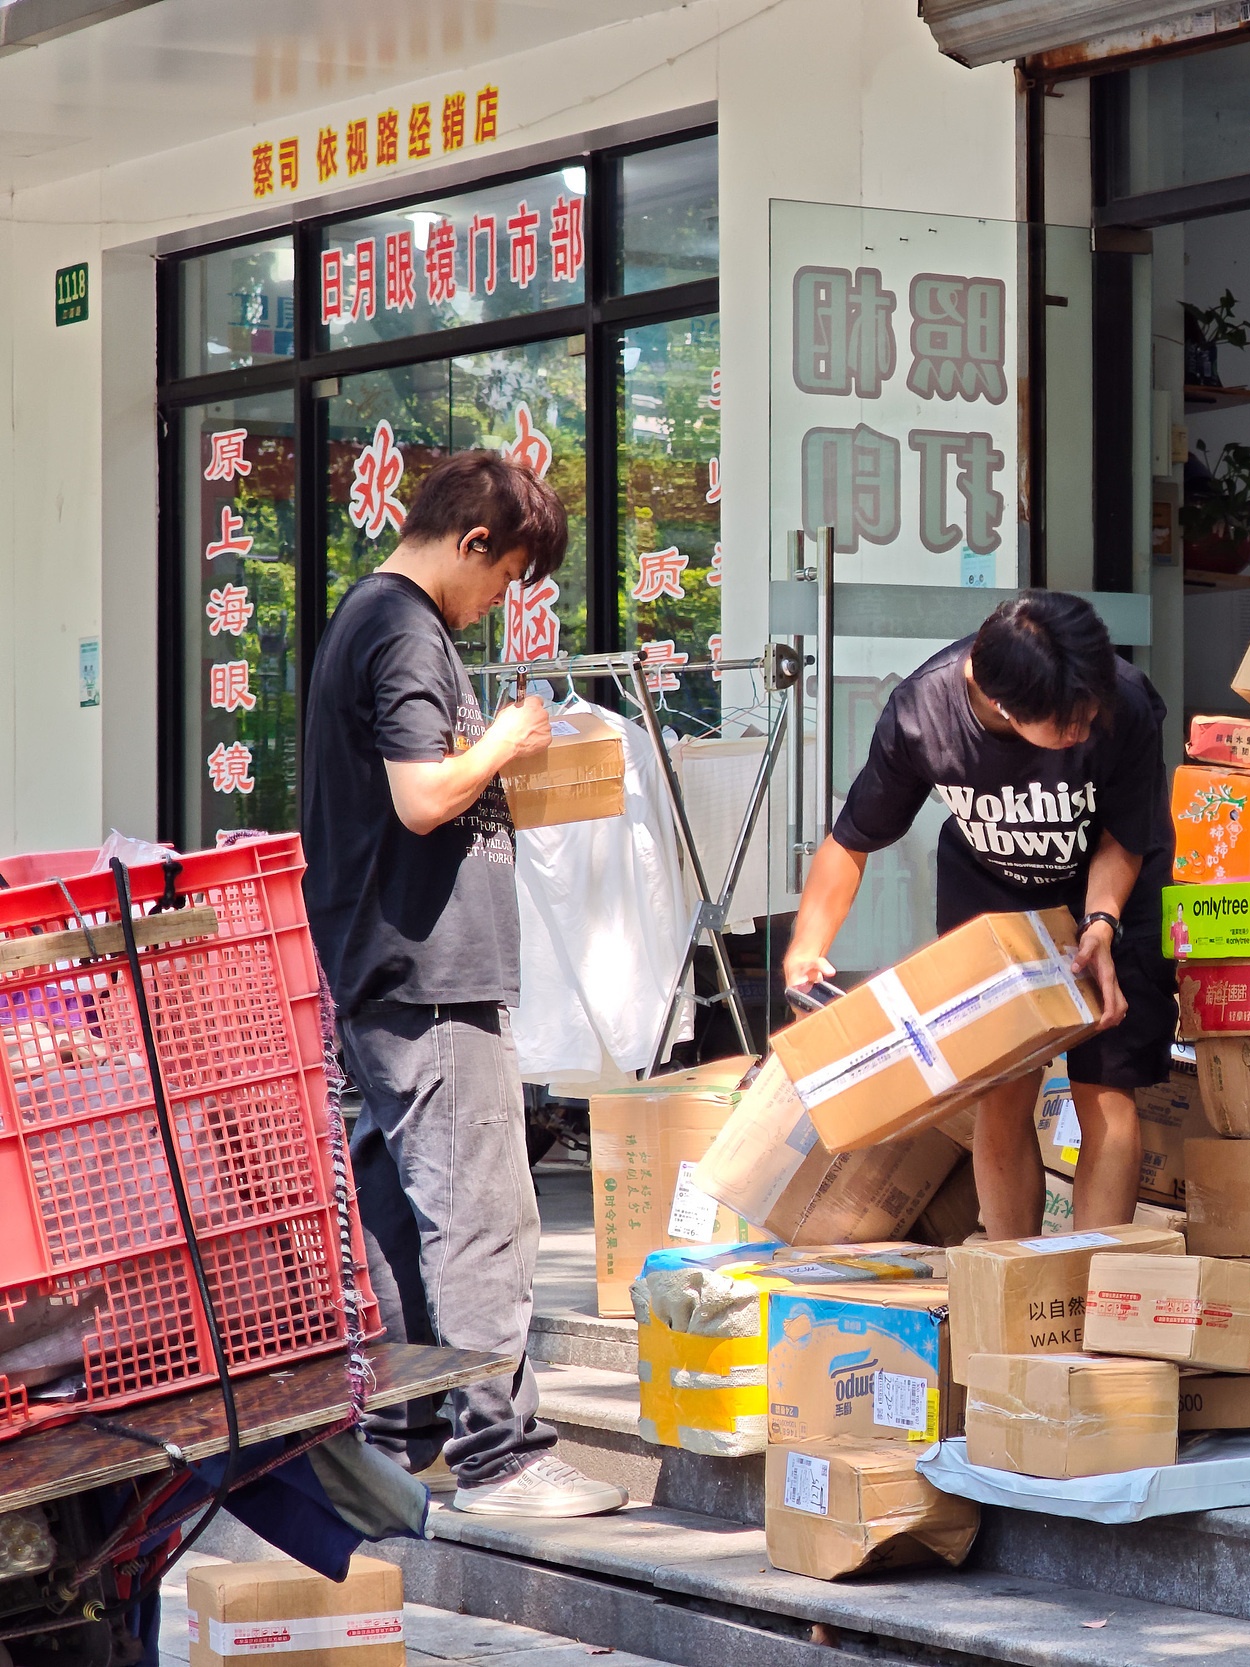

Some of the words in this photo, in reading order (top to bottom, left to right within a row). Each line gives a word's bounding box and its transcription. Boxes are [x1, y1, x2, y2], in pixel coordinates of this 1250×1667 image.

[252, 138, 300, 199] 蔡司
[316, 84, 499, 184] 依视路经销店
[58, 269, 86, 304] 1118
[320, 195, 586, 326] 日月眼镜门市部
[203, 427, 256, 836] 原上海眼镜
[935, 782, 1097, 823] Wokhist
[1192, 895, 1250, 920] onlytree
[604, 1195, 618, 1250] 时令水果
